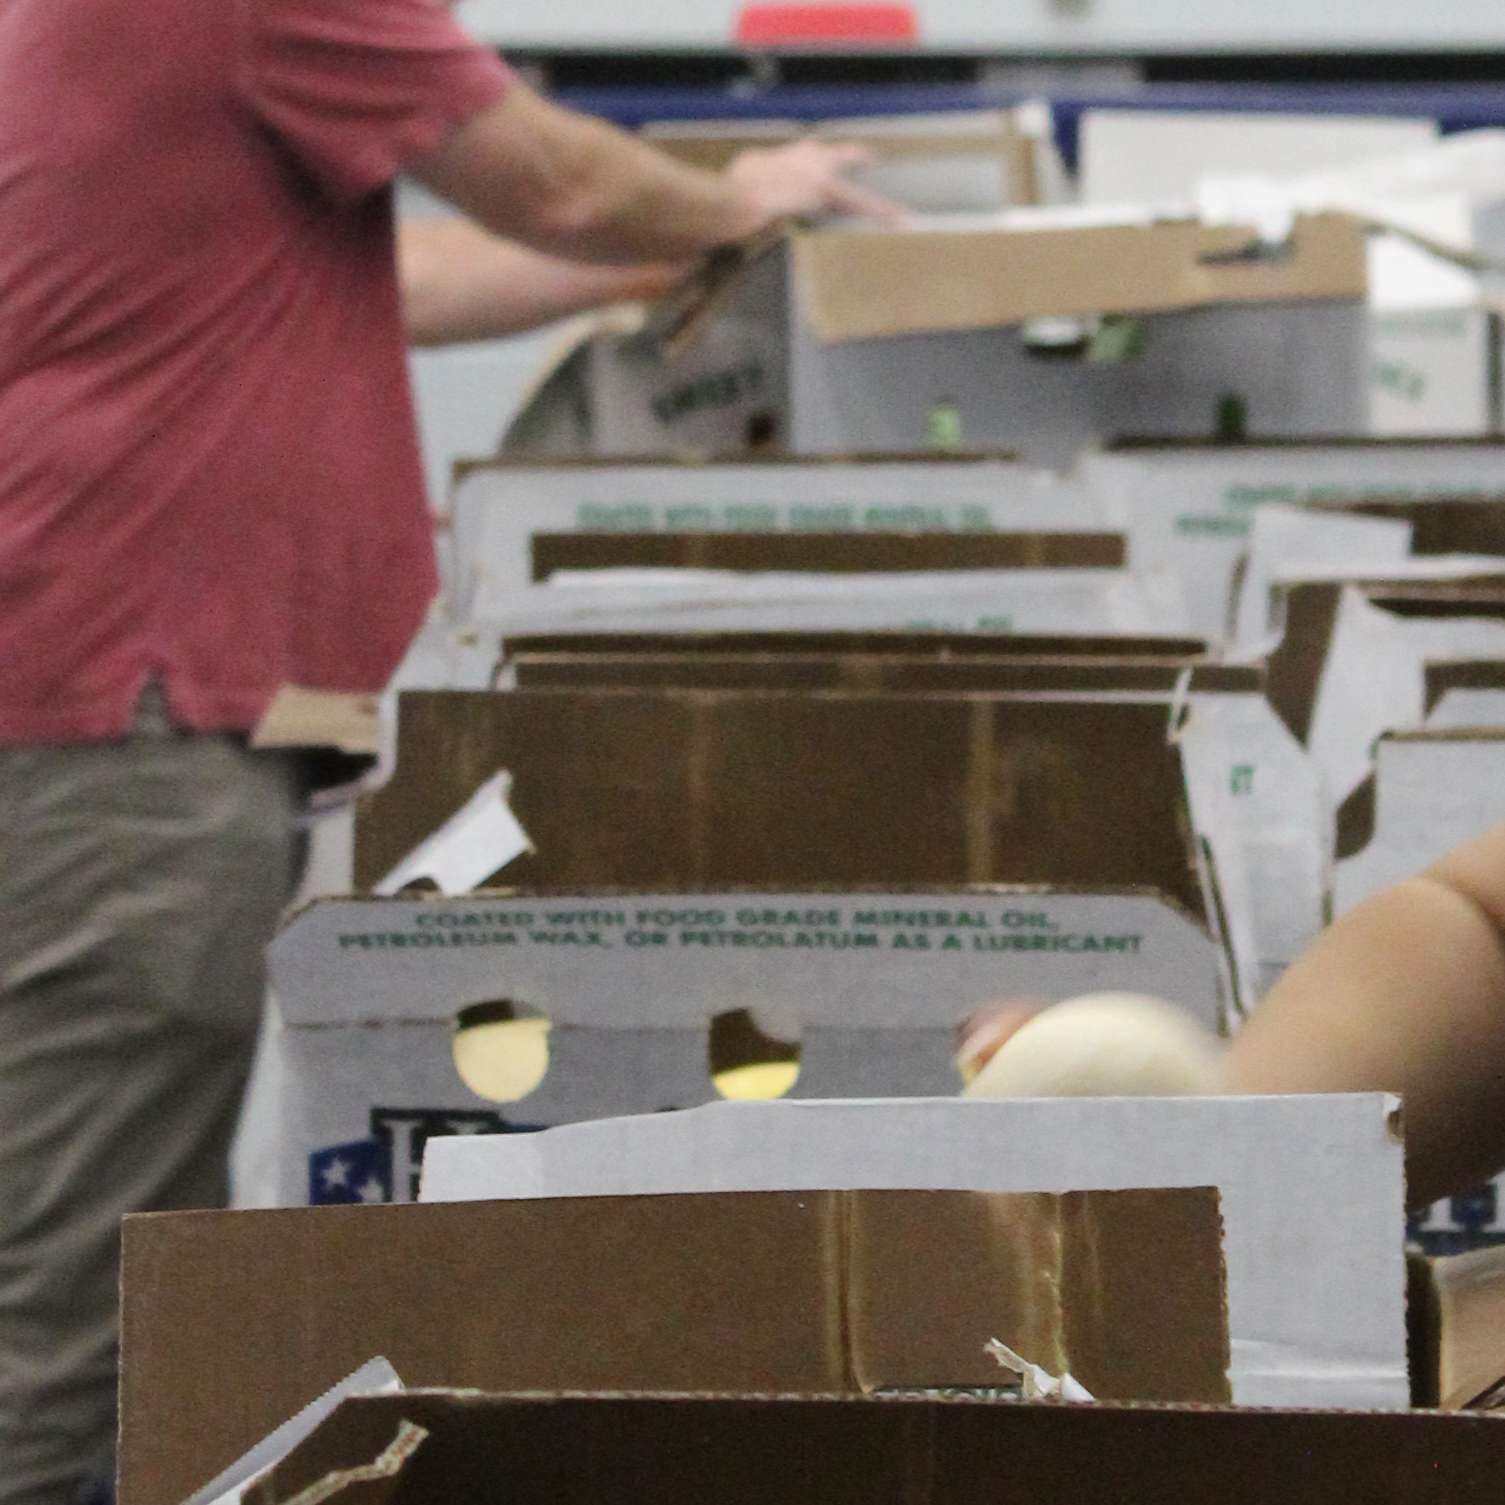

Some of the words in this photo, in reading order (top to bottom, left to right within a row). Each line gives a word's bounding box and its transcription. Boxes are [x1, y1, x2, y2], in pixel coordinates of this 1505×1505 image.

[546, 910, 626, 927] WITH
[637, 908, 726, 927] FOOD
[736, 908, 840, 927] GRADE
[852, 909, 988, 929] MINERAL
[624, 930, 668, 949] OR
[680, 930, 879, 950] PETROLATUM
[892, 932, 931, 950] AS
[941, 932, 962, 950] A
[973, 932, 1142, 952] LUBRICANT
